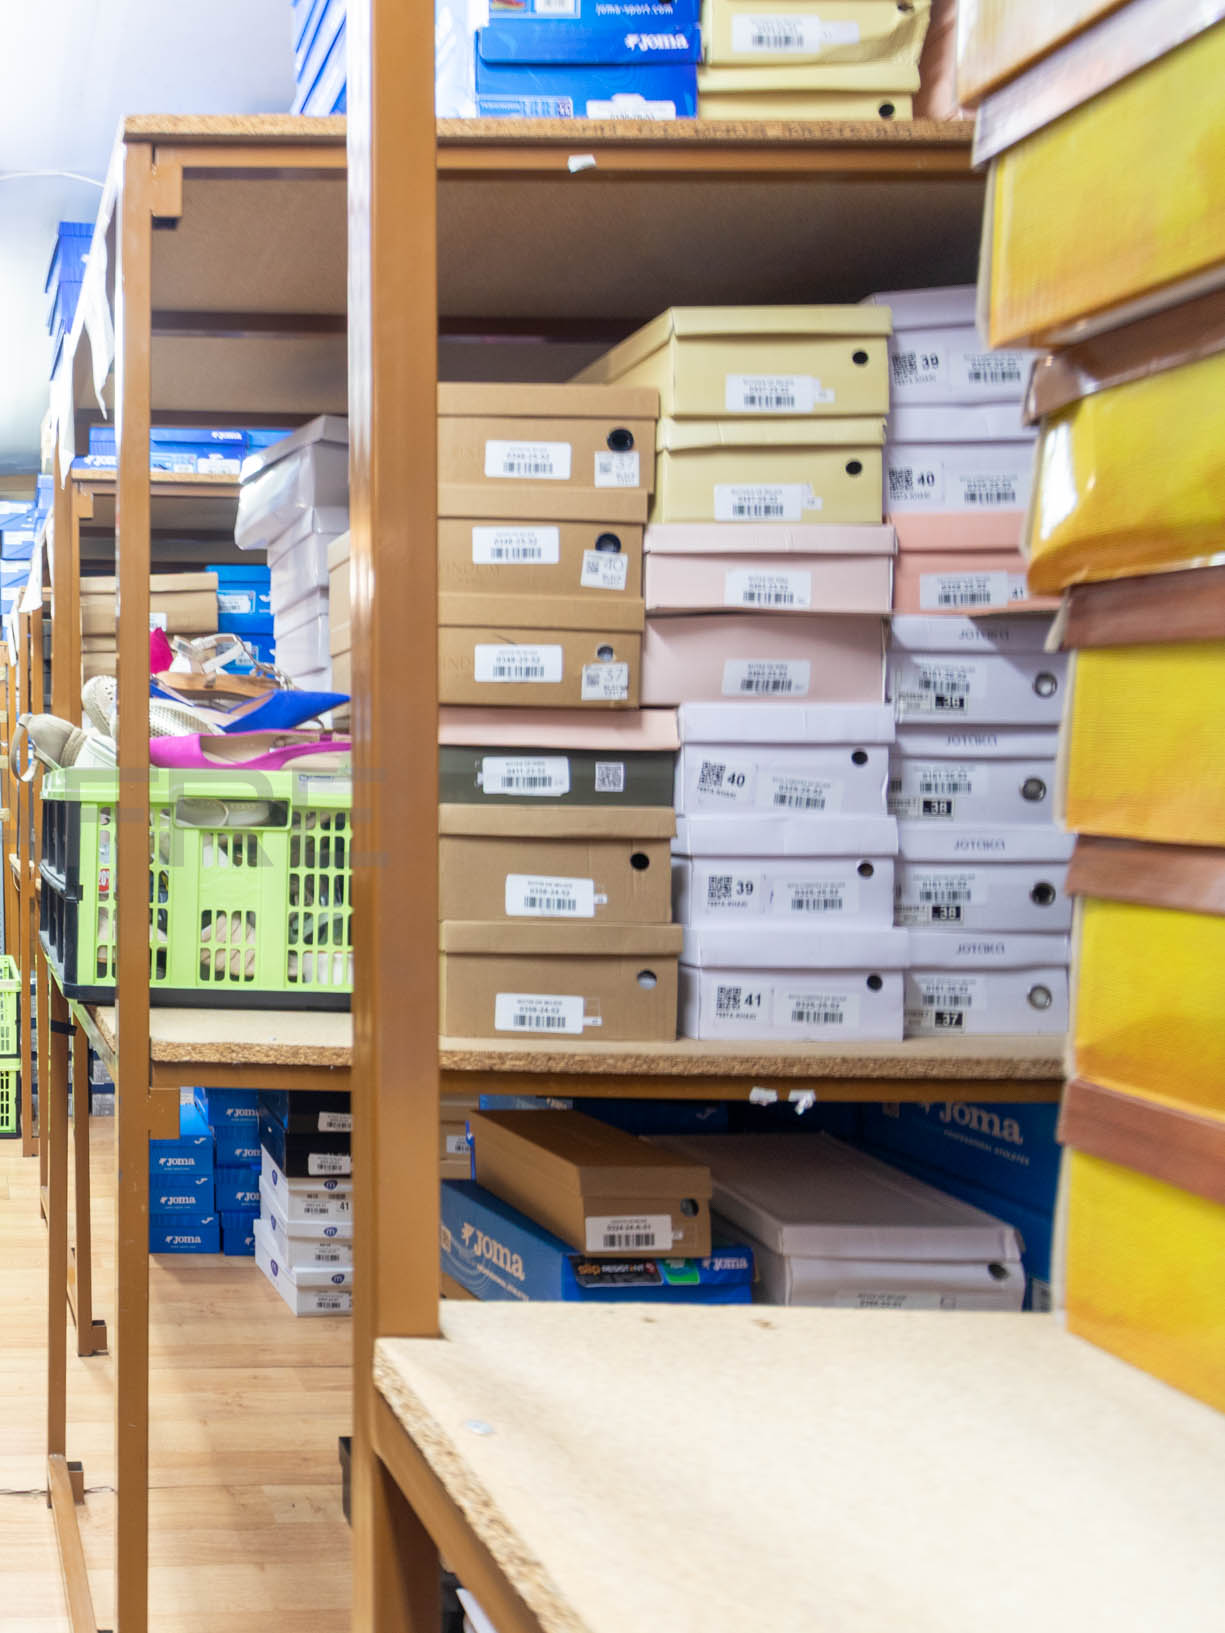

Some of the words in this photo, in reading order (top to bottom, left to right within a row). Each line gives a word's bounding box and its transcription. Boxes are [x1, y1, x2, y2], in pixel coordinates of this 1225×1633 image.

[727, 771, 746, 788] 40
[736, 881, 754, 895] 39
[744, 993, 762, 1007] 41
